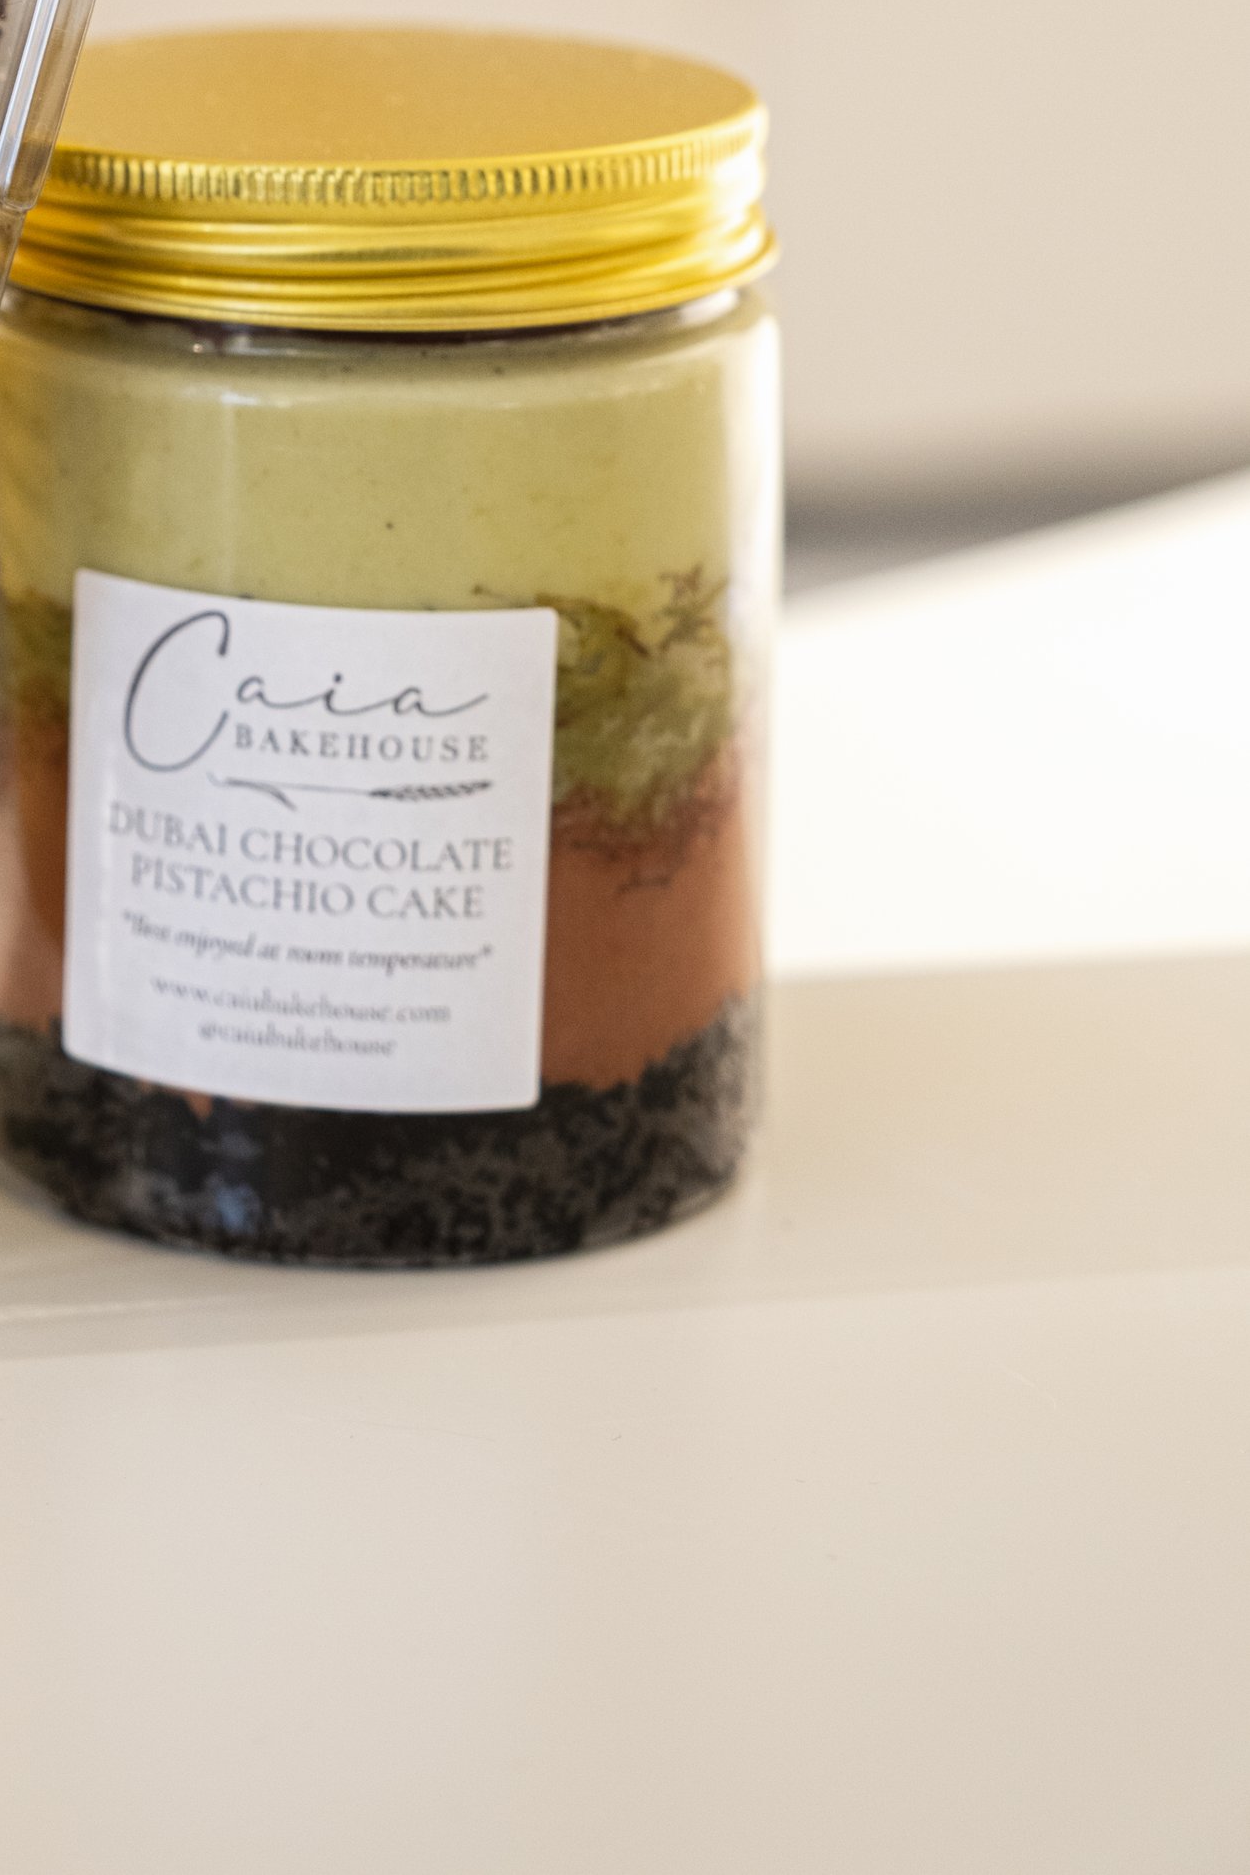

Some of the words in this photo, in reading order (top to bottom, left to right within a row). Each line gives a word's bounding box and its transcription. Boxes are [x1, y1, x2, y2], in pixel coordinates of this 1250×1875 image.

[124, 610, 489, 773] Caia
[234, 723, 490, 762] BAKEHOUSE
[109, 802, 227, 855] DUBAI
[240, 828, 513, 873] CHOCOLATE
[131, 854, 355, 916] PISTACHIO
[367, 884, 485, 920] CAKE
[286, 946, 343, 965] room
